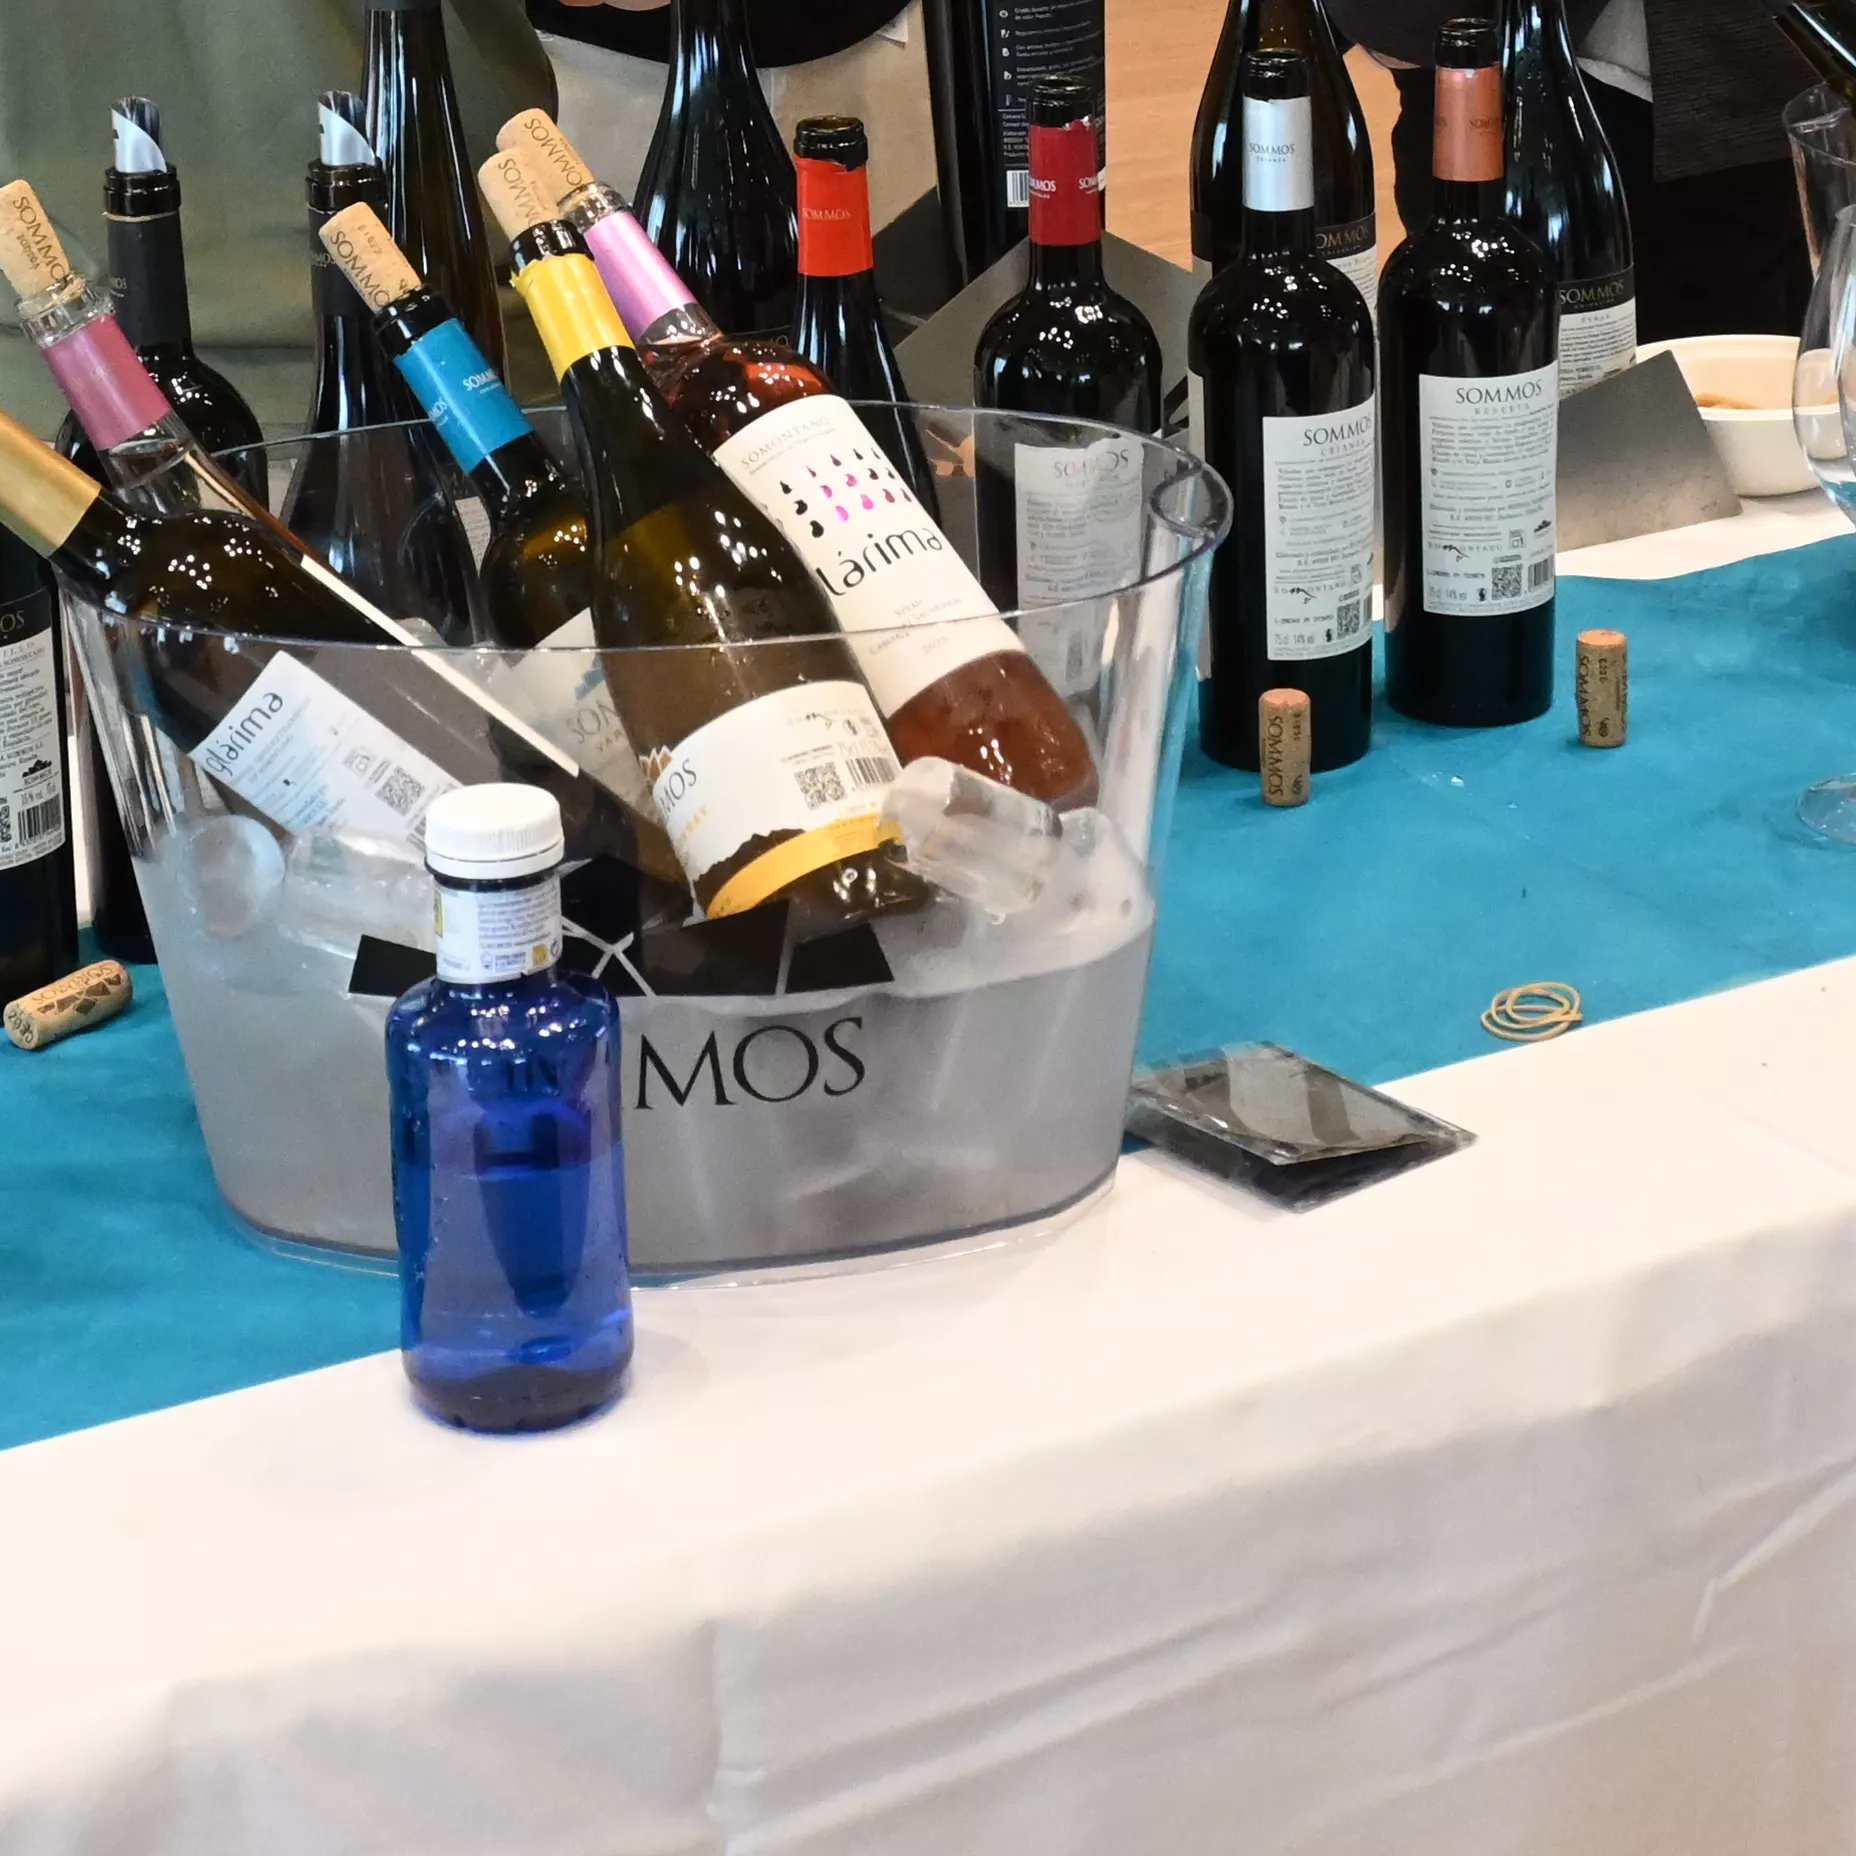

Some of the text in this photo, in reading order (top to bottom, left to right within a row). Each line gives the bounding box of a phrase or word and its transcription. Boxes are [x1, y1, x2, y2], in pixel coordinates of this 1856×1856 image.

[524, 117, 583, 188] SOMMO
[1247, 142, 1296, 156] SOMMOS
[497, 157, 544, 225] SOMM
[12, 196, 66, 281] SOMMO
[331, 231, 394, 305] SOMMO
[1315, 224, 1369, 249] OMMOS
[1559, 279, 1624, 305] SOMMOS
[1455, 378, 1542, 405] SOMMOS
[741, 416, 832, 470] SOMONTANO
[565, 698, 616, 745] SOM
[1268, 714, 1284, 797] SOMMOS
[658, 757, 698, 821] MOS
[633, 1015, 867, 1111] MOS
